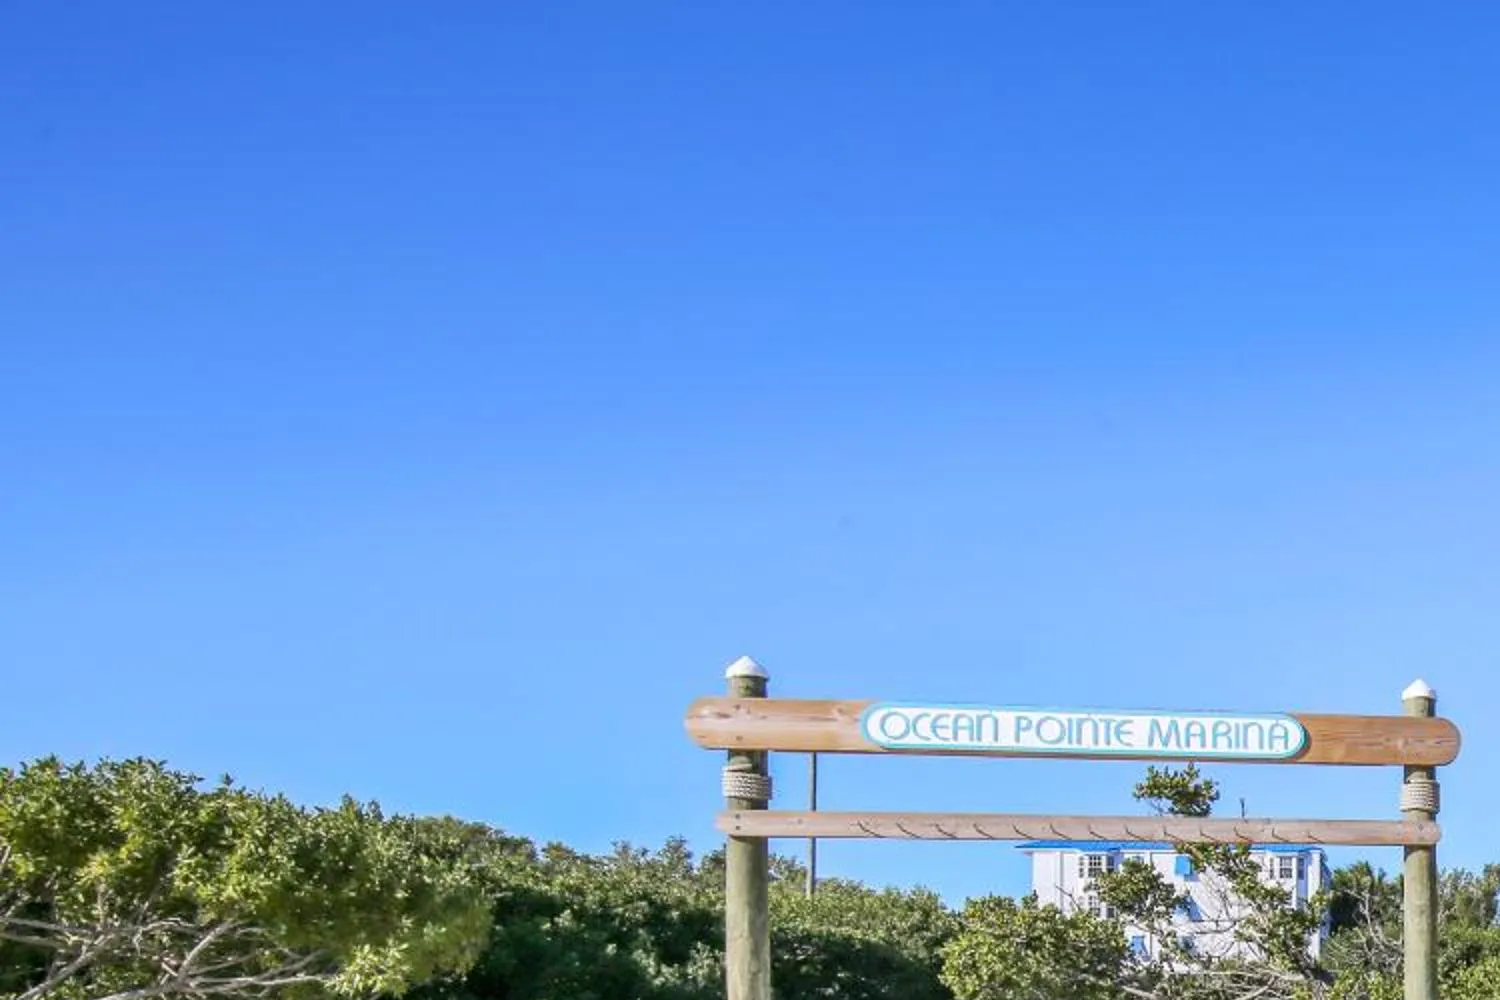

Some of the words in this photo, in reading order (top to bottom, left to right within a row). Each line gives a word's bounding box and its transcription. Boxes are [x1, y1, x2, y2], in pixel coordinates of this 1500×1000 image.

[879, 711, 998, 743] OCEAN
[1014, 714, 1134, 746] POINTE
[1147, 717, 1290, 751] MARINA
